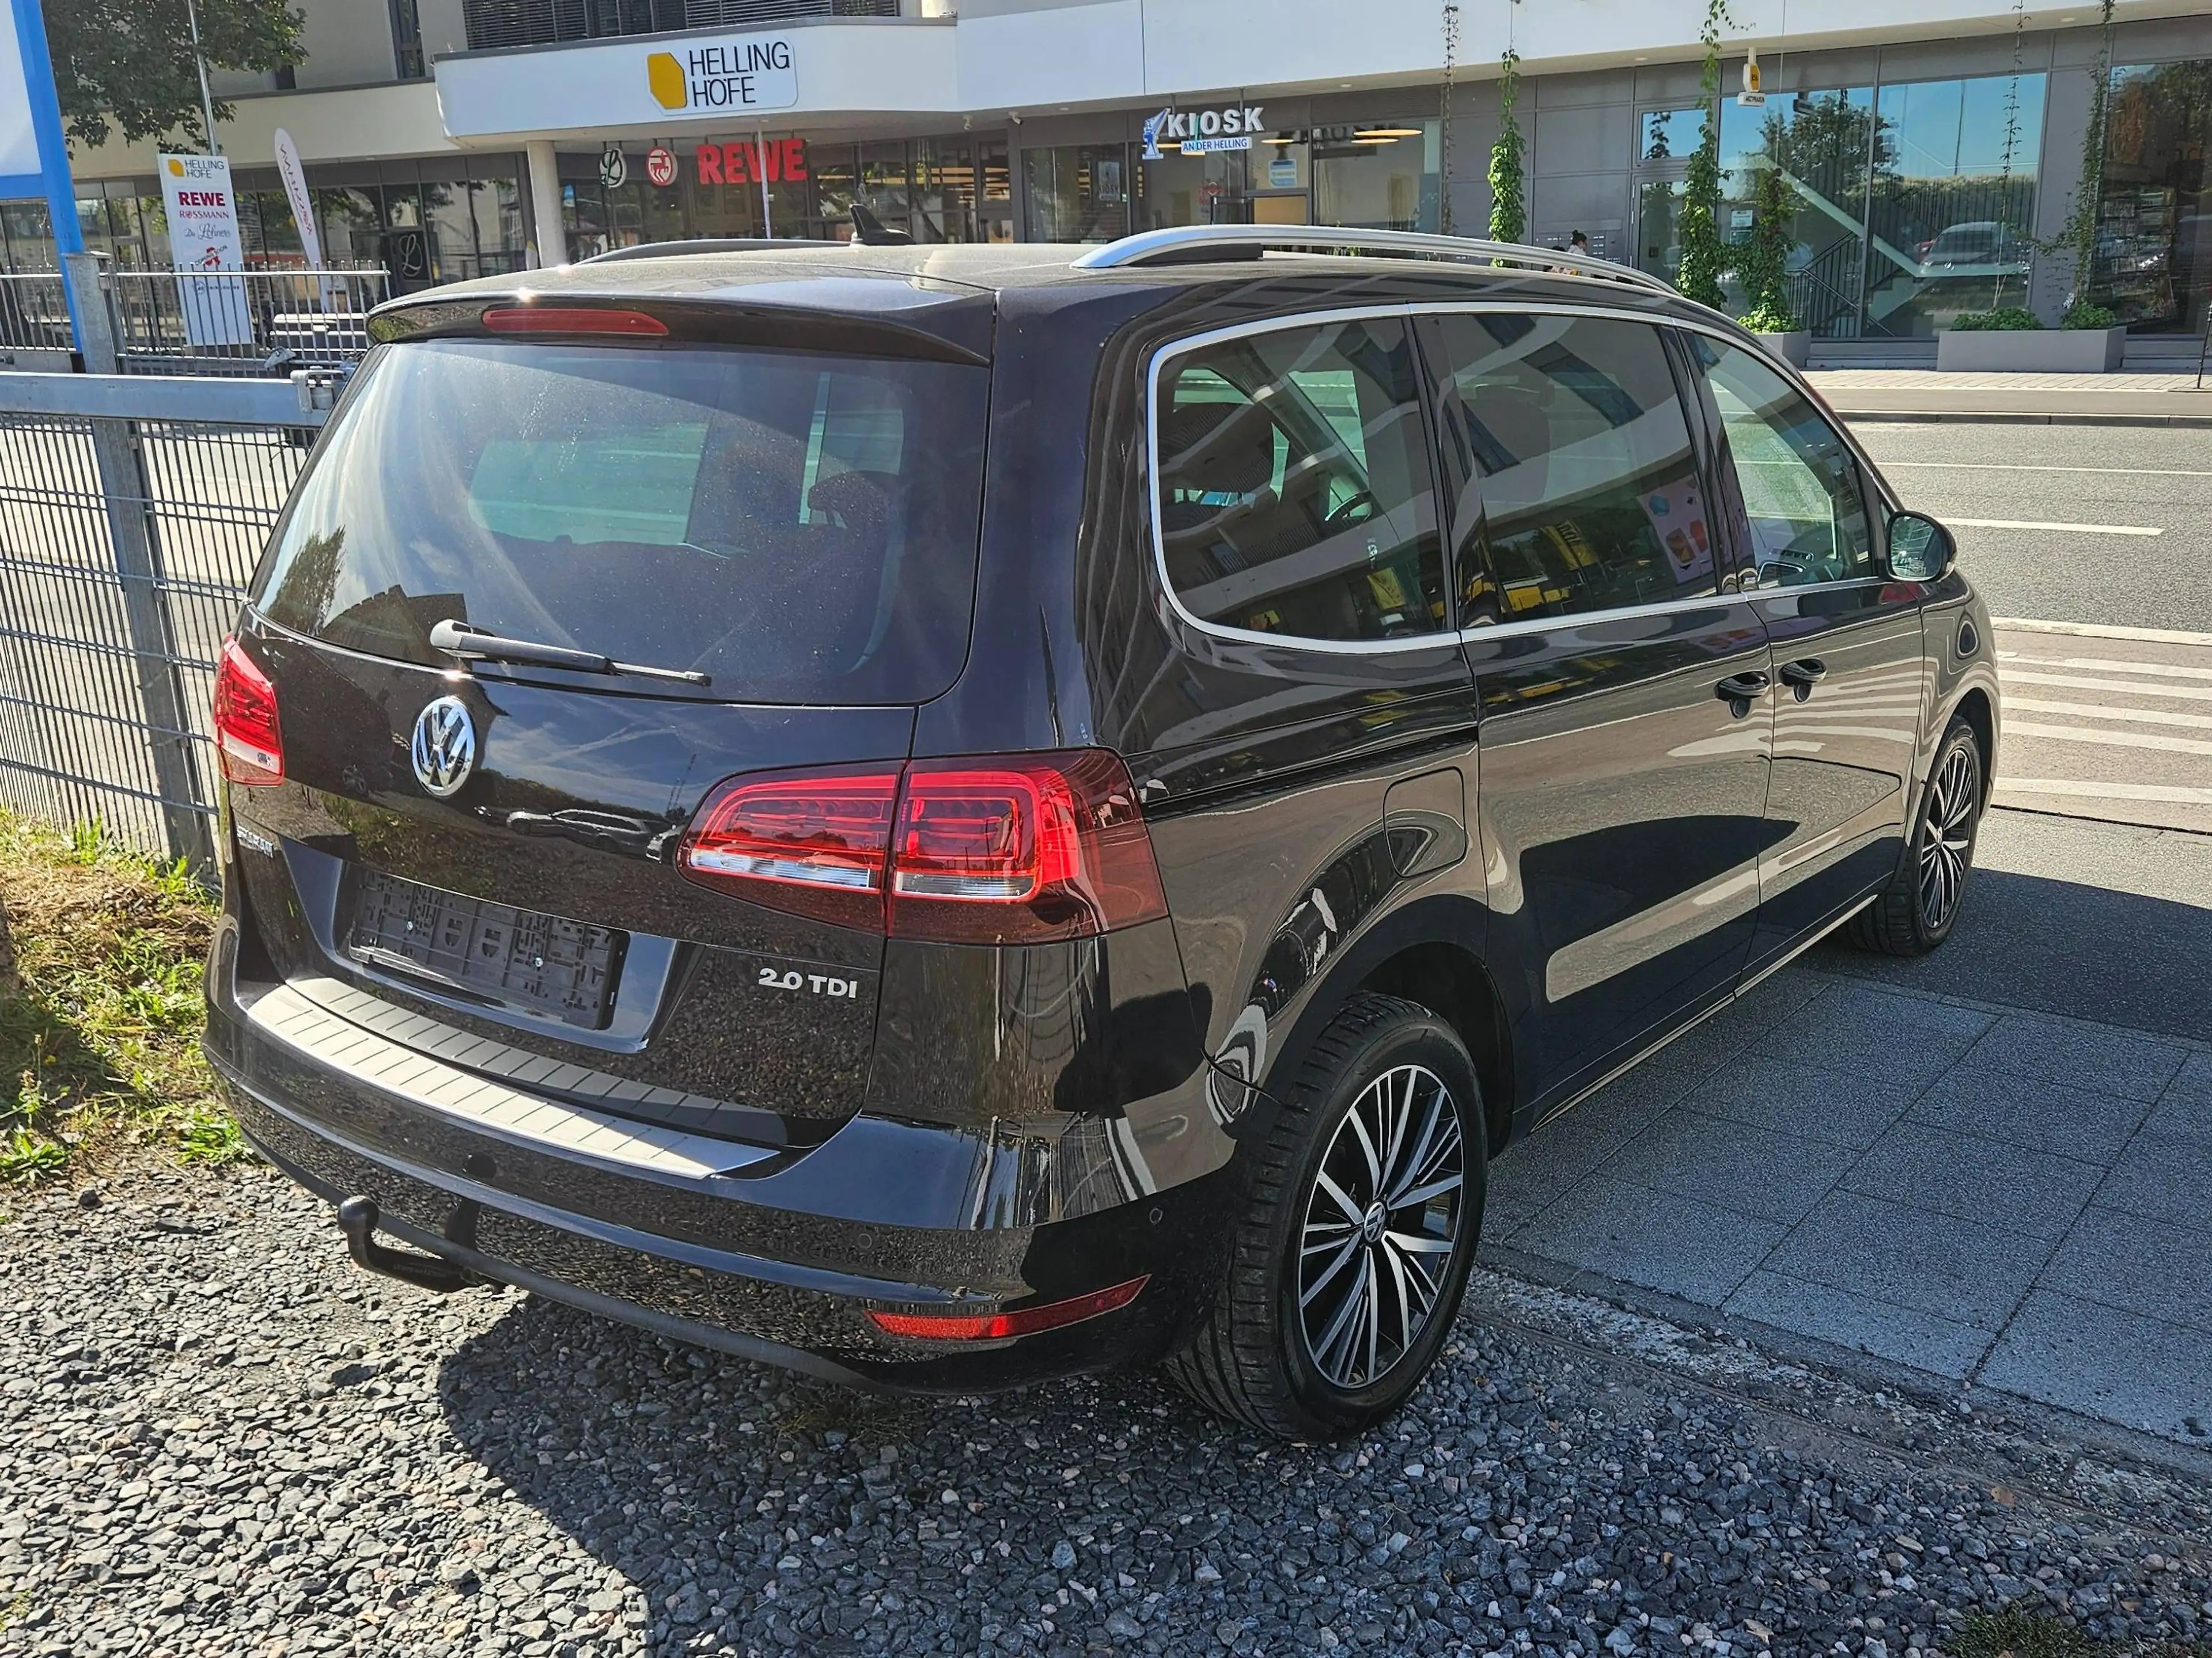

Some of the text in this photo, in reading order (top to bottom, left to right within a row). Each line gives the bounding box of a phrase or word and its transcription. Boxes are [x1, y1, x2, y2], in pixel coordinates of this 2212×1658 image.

[689, 41, 790, 76] HELLING
[692, 76, 756, 107] HÖFE
[1168, 107, 1264, 137] KIOSK
[1183, 138, 1247, 151] AN DER HELLING
[185, 160, 224, 169] HELLING
[695, 138, 808, 185] REWE
[178, 191, 226, 206] REWE
[179, 210, 229, 219] ROSSMANN
[808, 974, 857, 998] TDI
